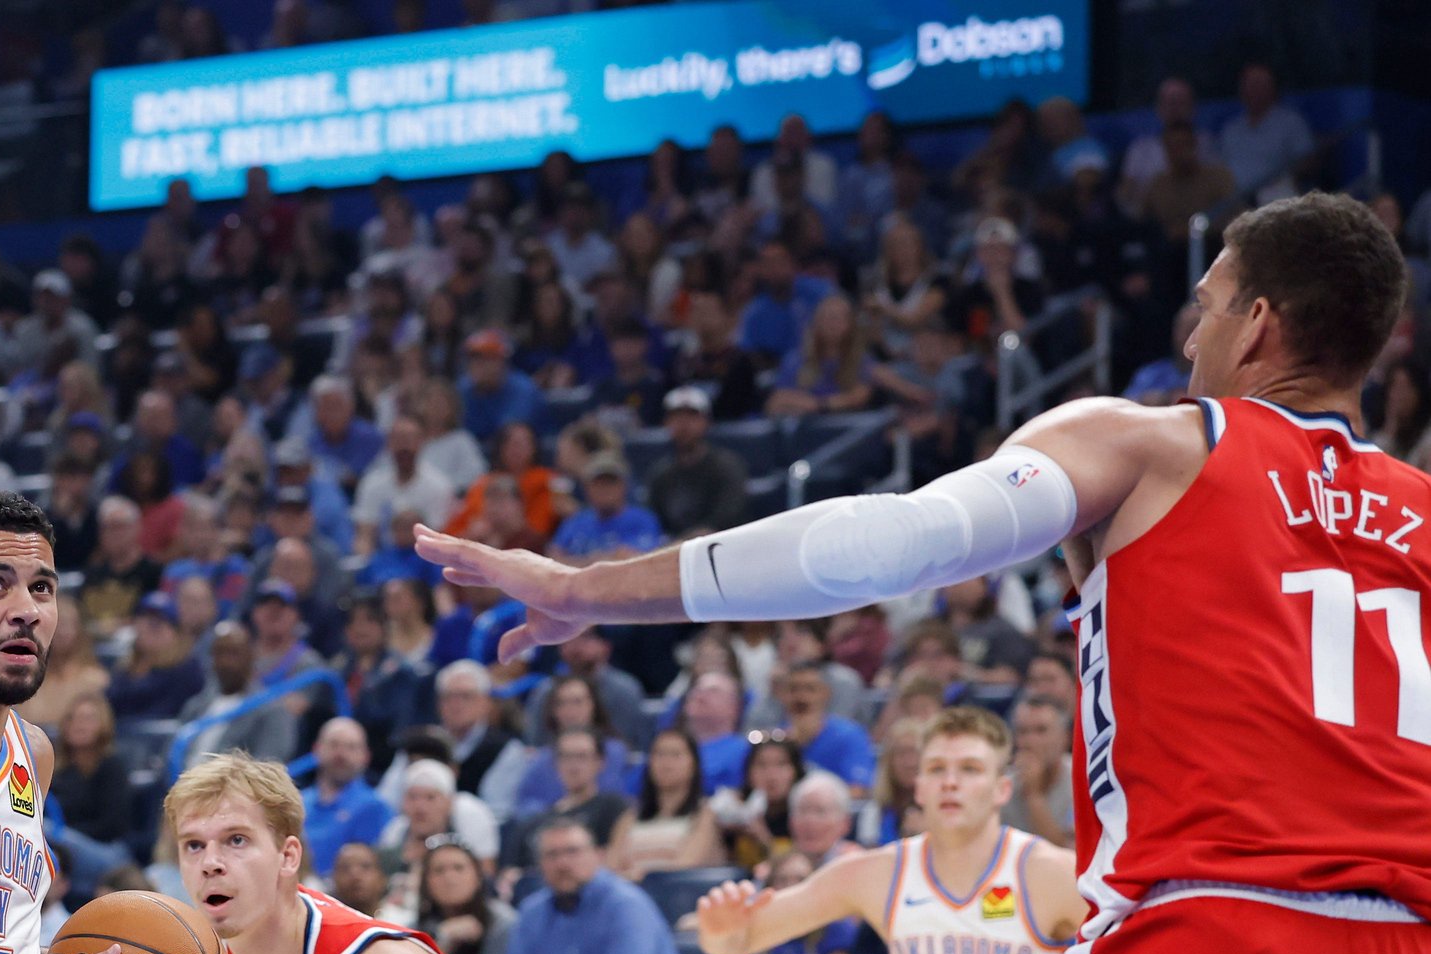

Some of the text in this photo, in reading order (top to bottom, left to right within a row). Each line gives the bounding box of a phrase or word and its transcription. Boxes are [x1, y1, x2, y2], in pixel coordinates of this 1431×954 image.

[917, 14, 1064, 67] Dobson
[132, 46, 567, 133] BORN HERE. BUILT HERE.
[120, 91, 579, 180] FAST, RELIABLE INTERNET.
[1267, 470, 1424, 554] LOPEZ
[1280, 567, 1431, 746] 11
